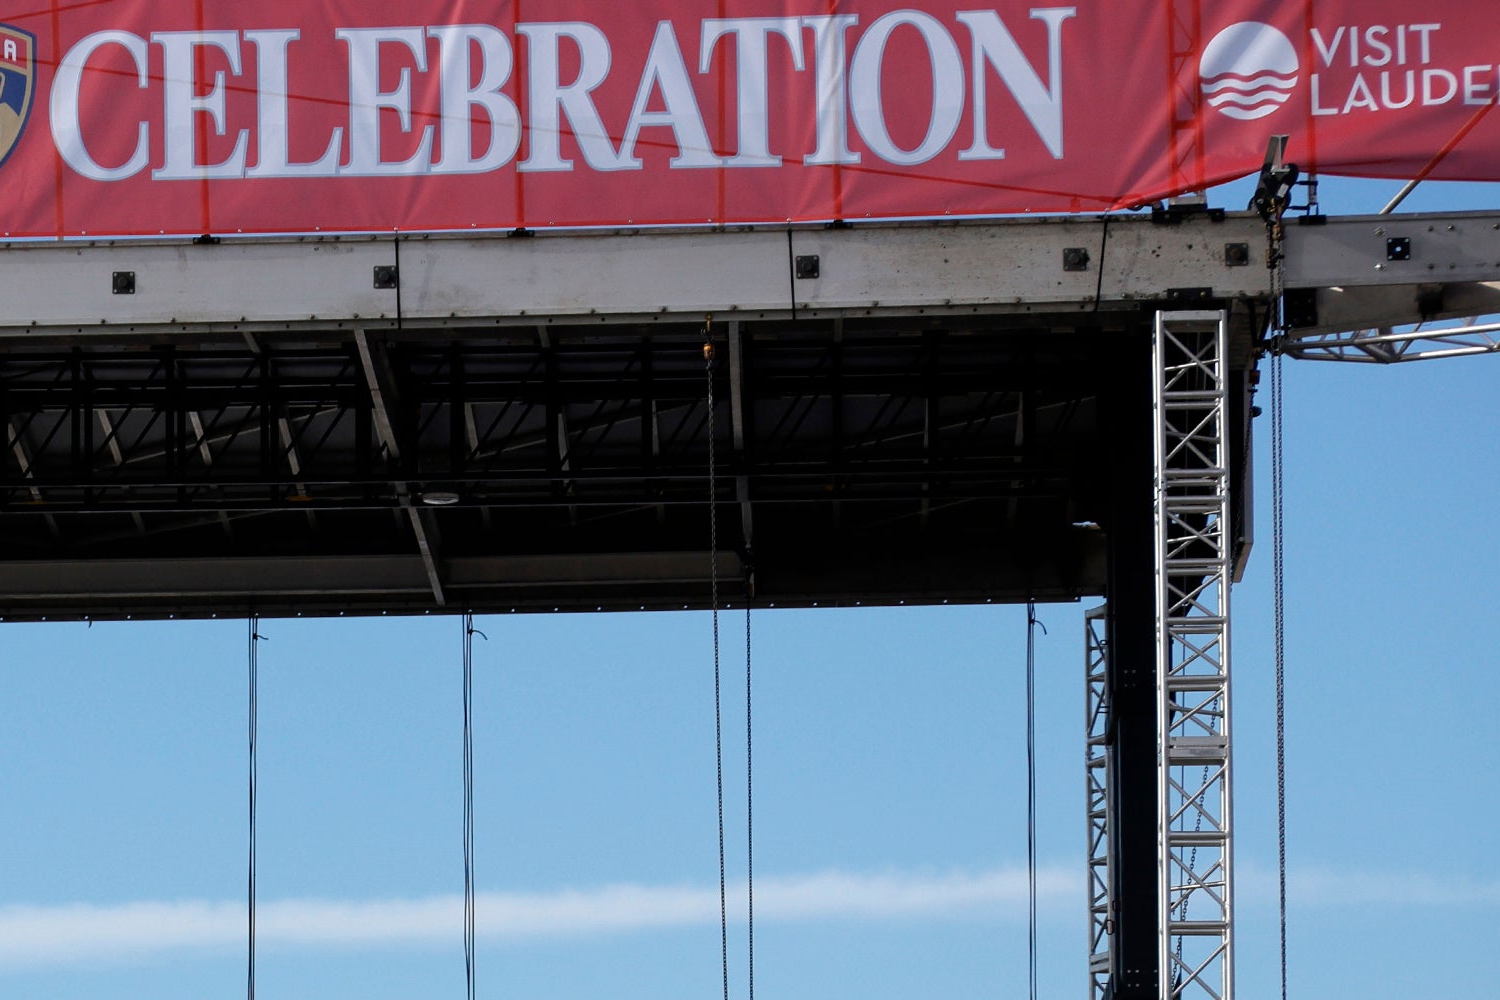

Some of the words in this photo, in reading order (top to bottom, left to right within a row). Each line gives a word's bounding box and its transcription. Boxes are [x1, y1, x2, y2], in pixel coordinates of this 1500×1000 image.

[1310, 23, 1441, 67] VISIT
[49, 7, 1077, 182] CELEBRATION
[1311, 64, 1500, 116] LAUDE
